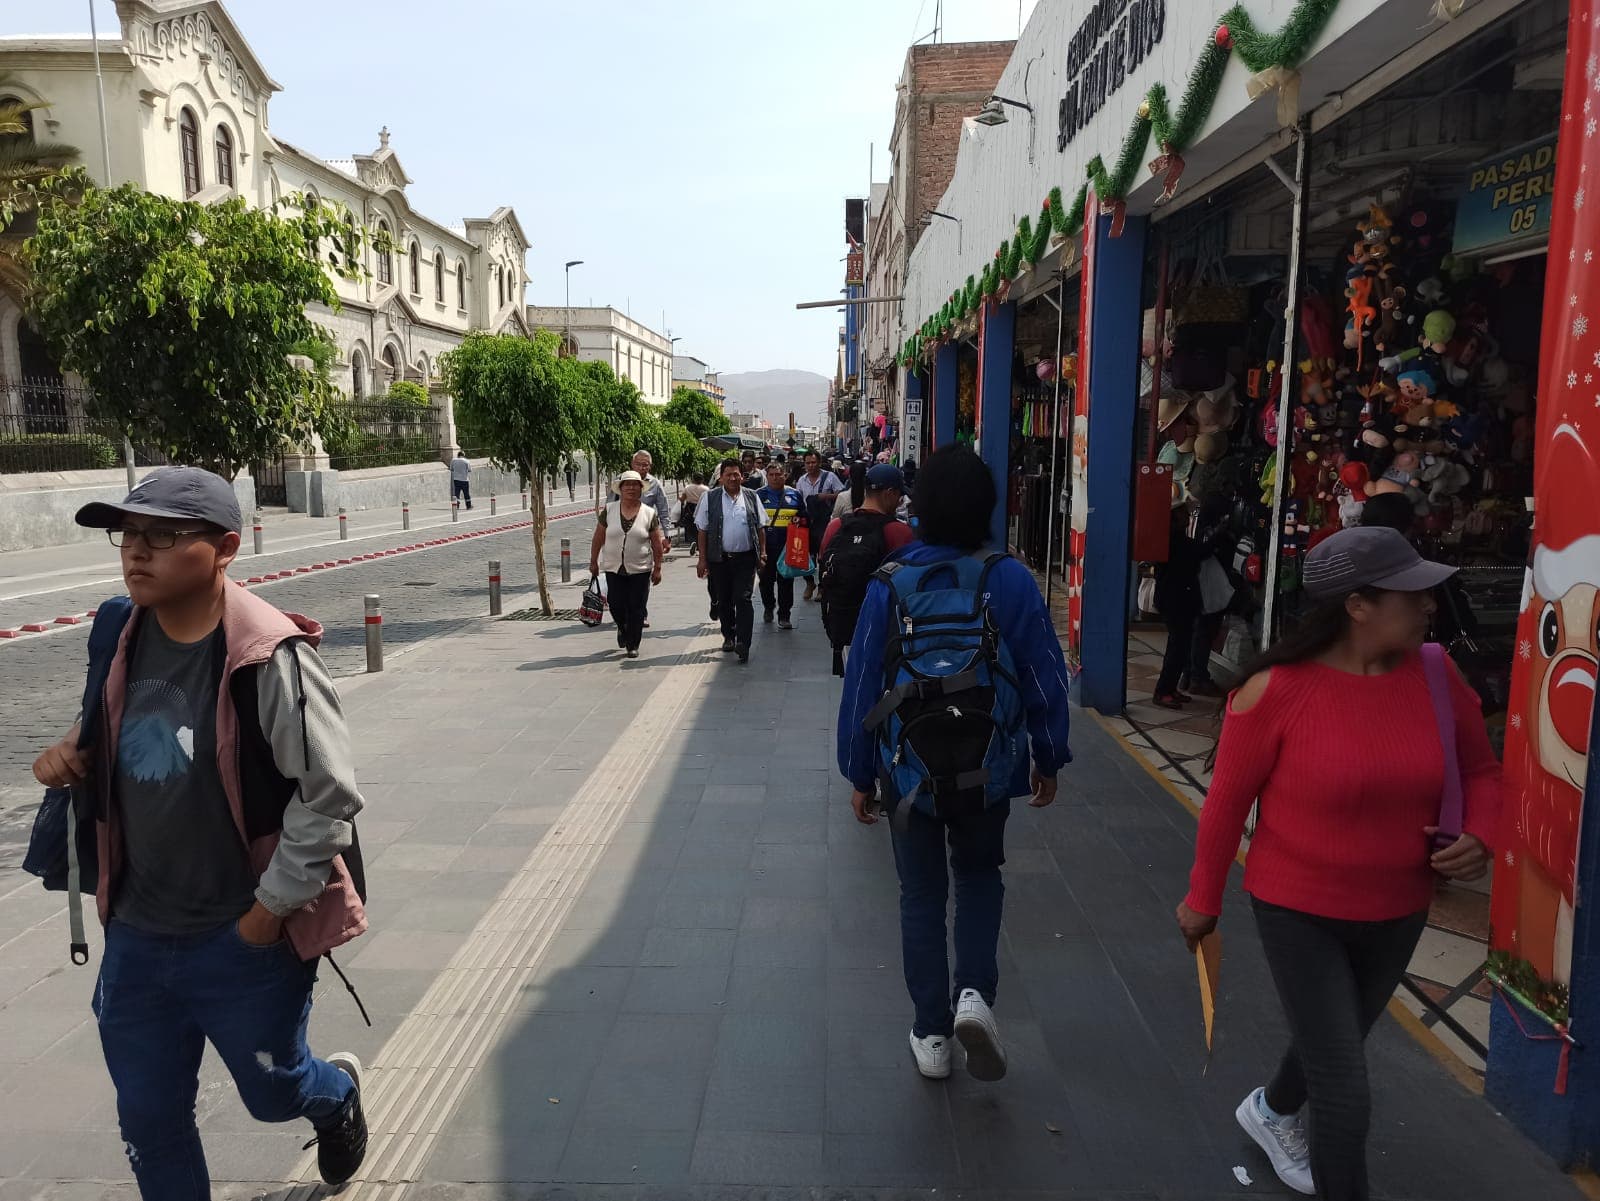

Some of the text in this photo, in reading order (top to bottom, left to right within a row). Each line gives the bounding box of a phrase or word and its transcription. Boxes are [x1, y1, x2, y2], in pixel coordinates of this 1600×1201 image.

[1077, 41, 1108, 130] JUAN
[1108, 16, 1126, 96] DE
[1510, 204, 1537, 234] 05
